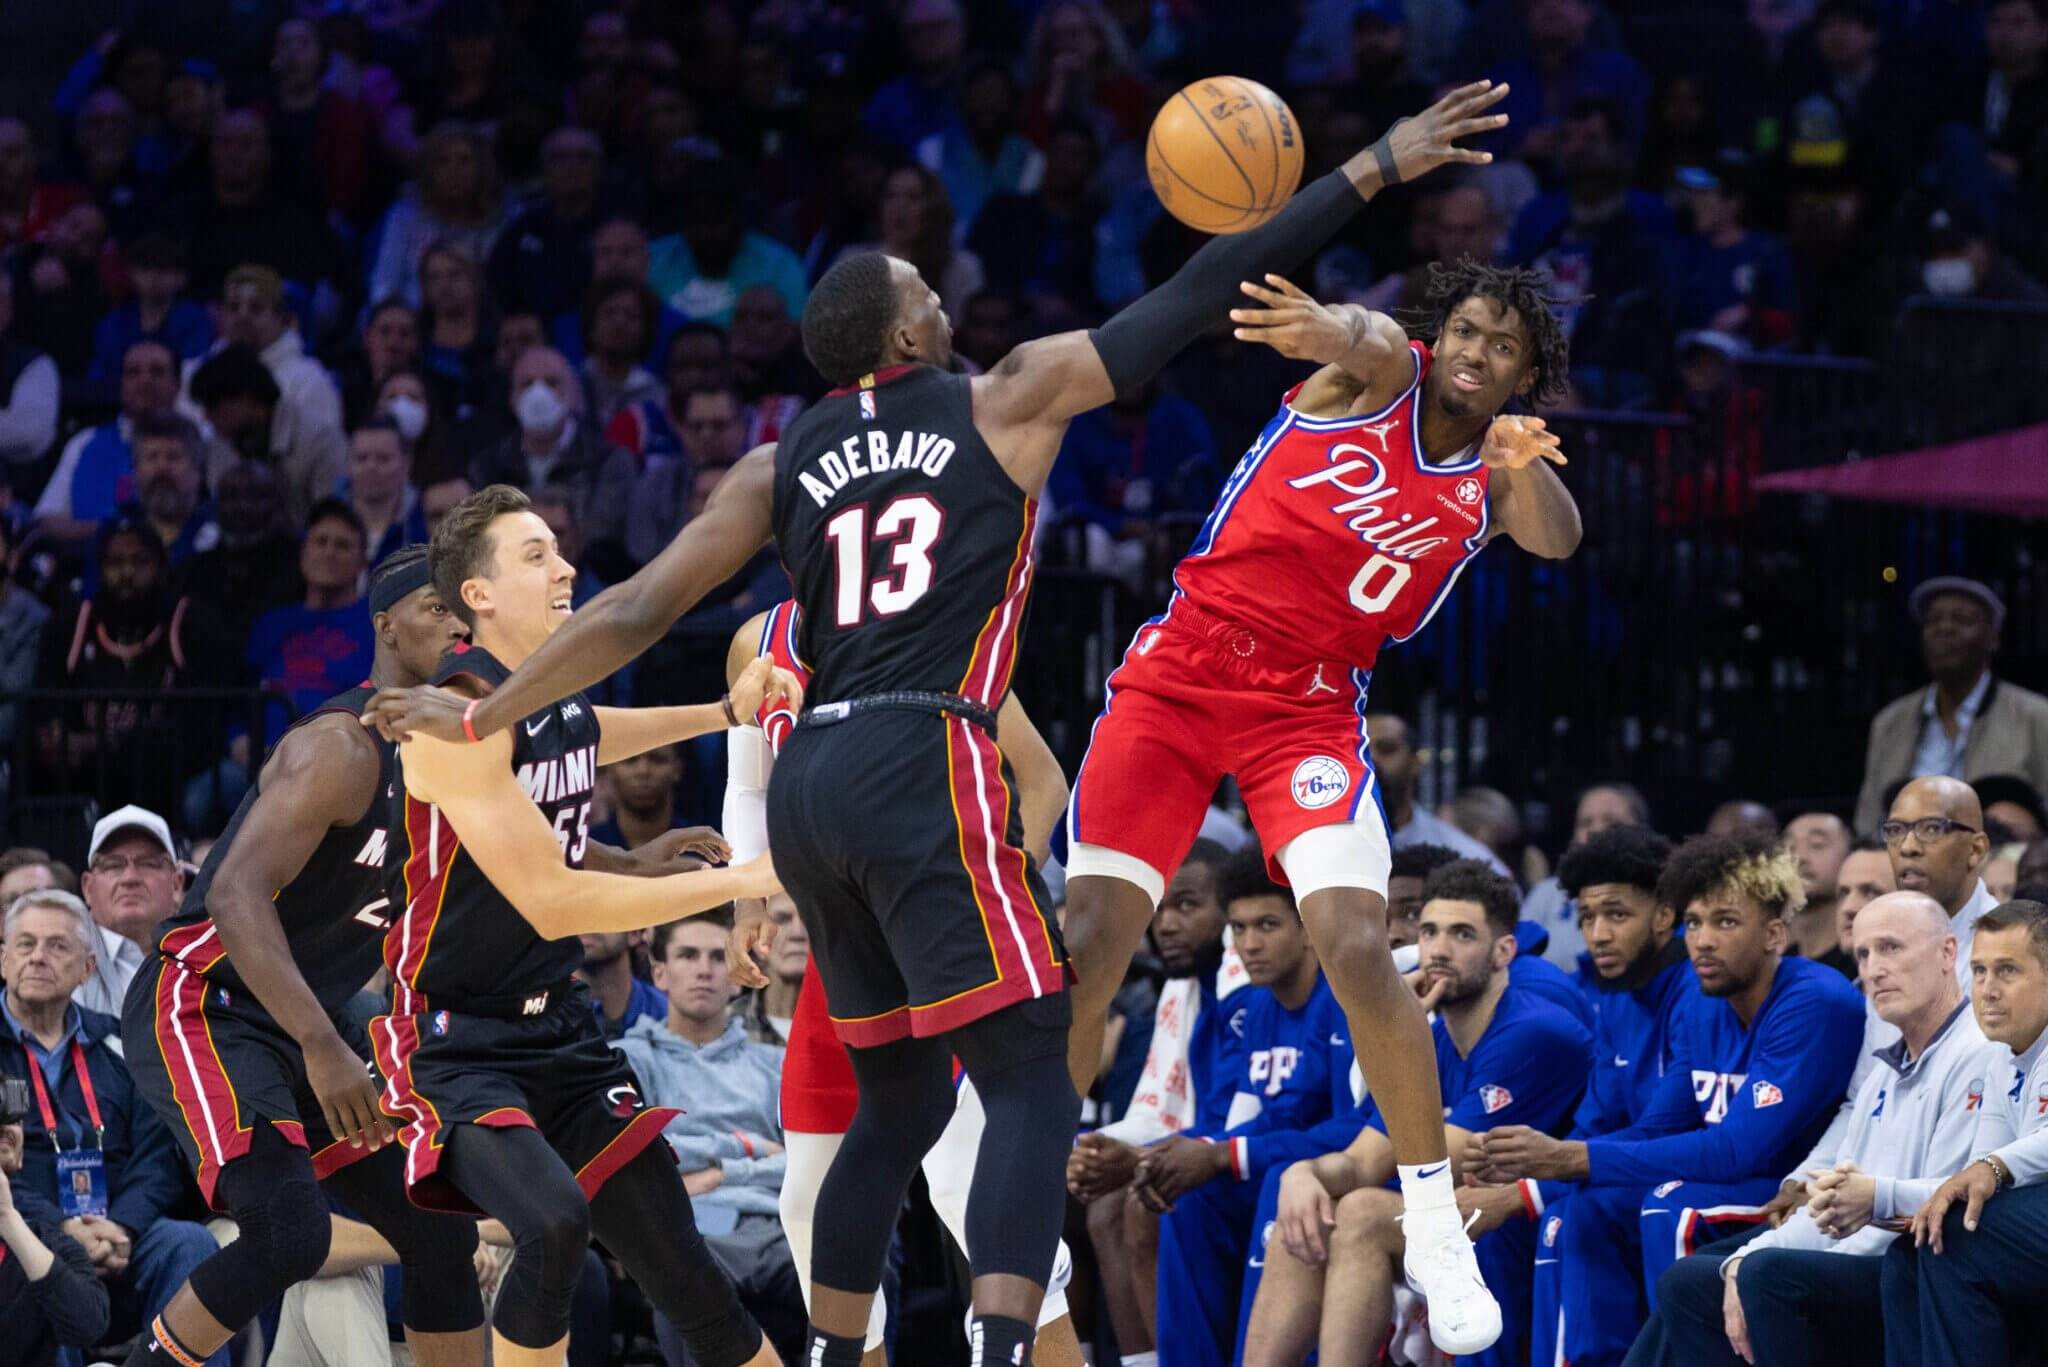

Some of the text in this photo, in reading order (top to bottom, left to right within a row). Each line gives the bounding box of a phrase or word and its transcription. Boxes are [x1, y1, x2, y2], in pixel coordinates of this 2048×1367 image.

[798, 430, 956, 508] ADEBAYO
[1288, 443, 1449, 560] Phila
[1436, 493, 1479, 526] crypto.com
[826, 493, 944, 630] 13
[1348, 553, 1412, 614] 0
[516, 744, 596, 803] MIAMI
[1297, 775, 1343, 799] 76ers
[553, 802, 592, 863] 55
